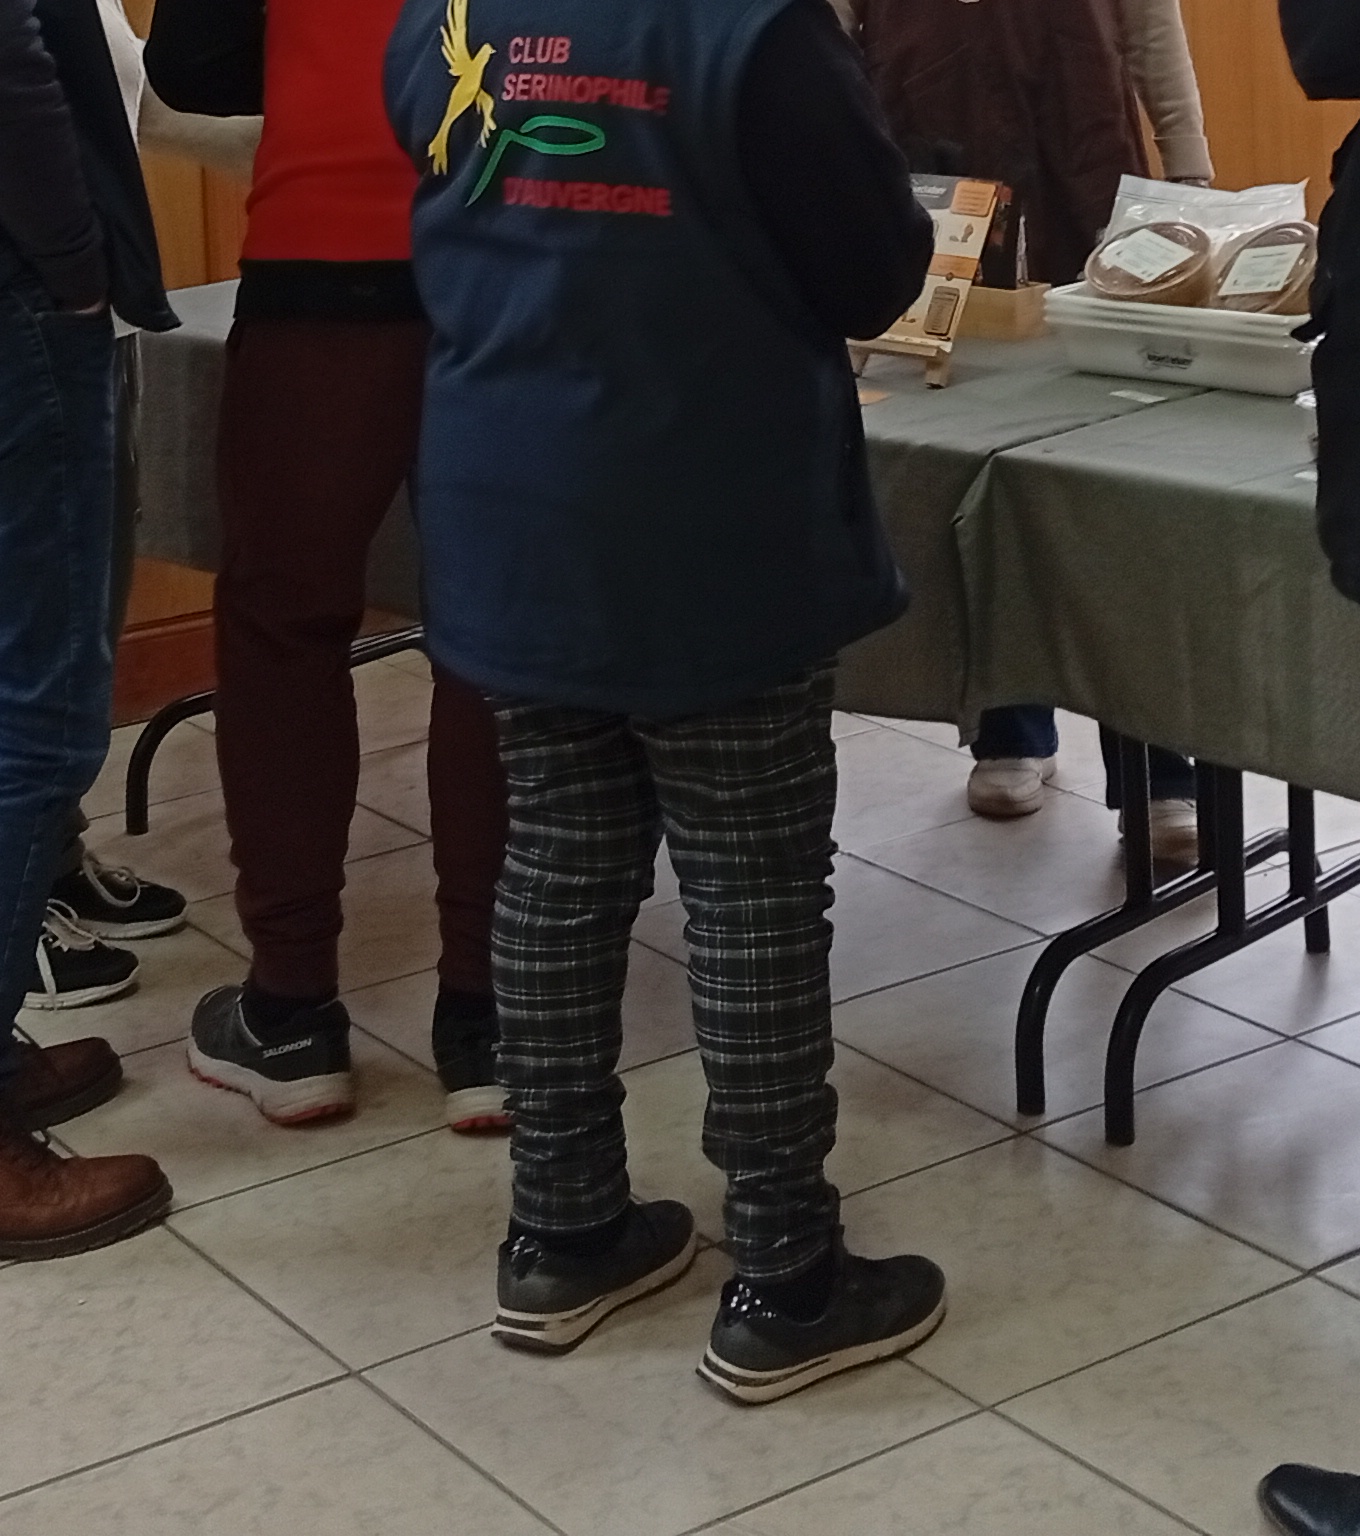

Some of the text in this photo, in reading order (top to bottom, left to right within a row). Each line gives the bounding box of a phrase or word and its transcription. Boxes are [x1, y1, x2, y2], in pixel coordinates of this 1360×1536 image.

[508, 36, 572, 65] CLUB
[501, 72, 671, 116] SERINOPHILE
[262, 1037, 312, 1059] SALOMON
